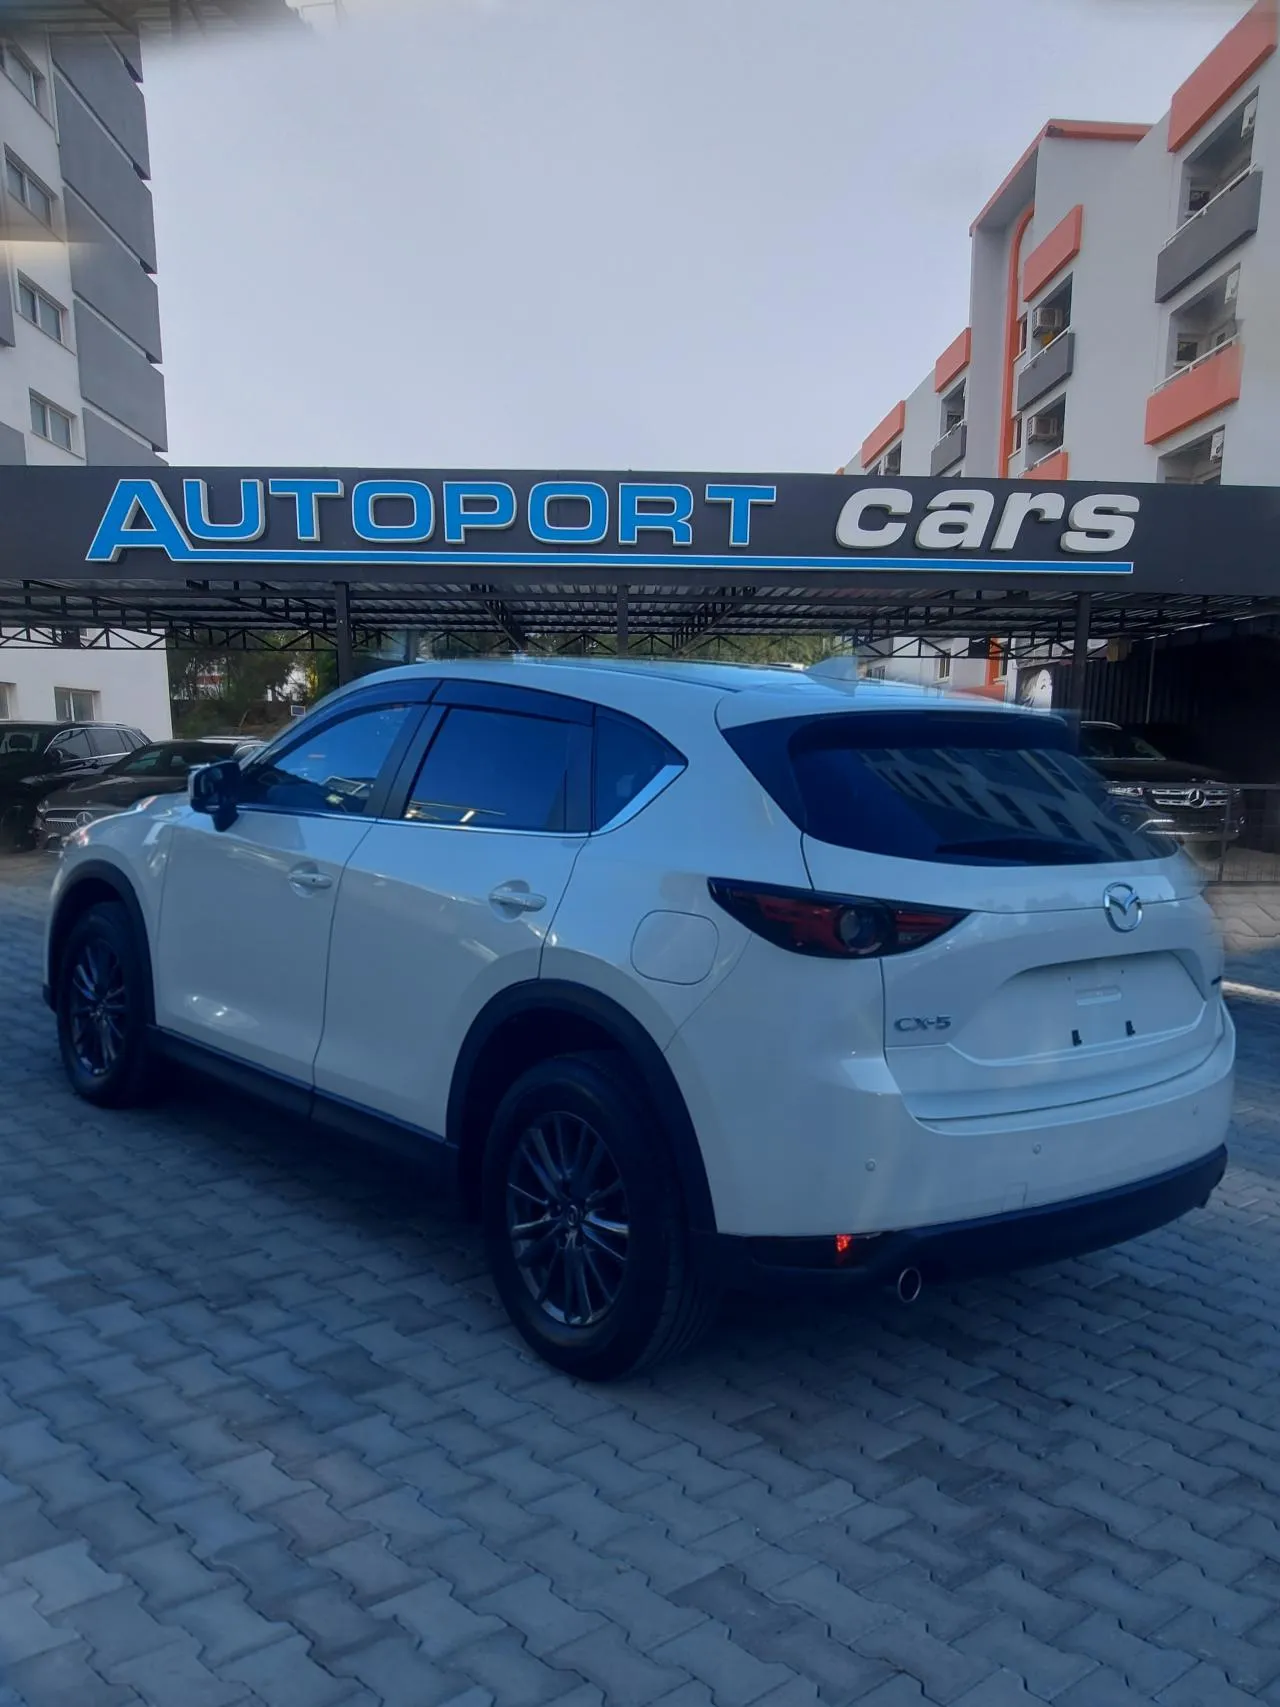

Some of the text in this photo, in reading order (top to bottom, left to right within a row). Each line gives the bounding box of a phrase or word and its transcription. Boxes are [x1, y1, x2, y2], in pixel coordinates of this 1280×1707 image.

[85, 478, 1141, 562] AUTOPORT cars
[894, 1016, 951, 1031] CX-5
